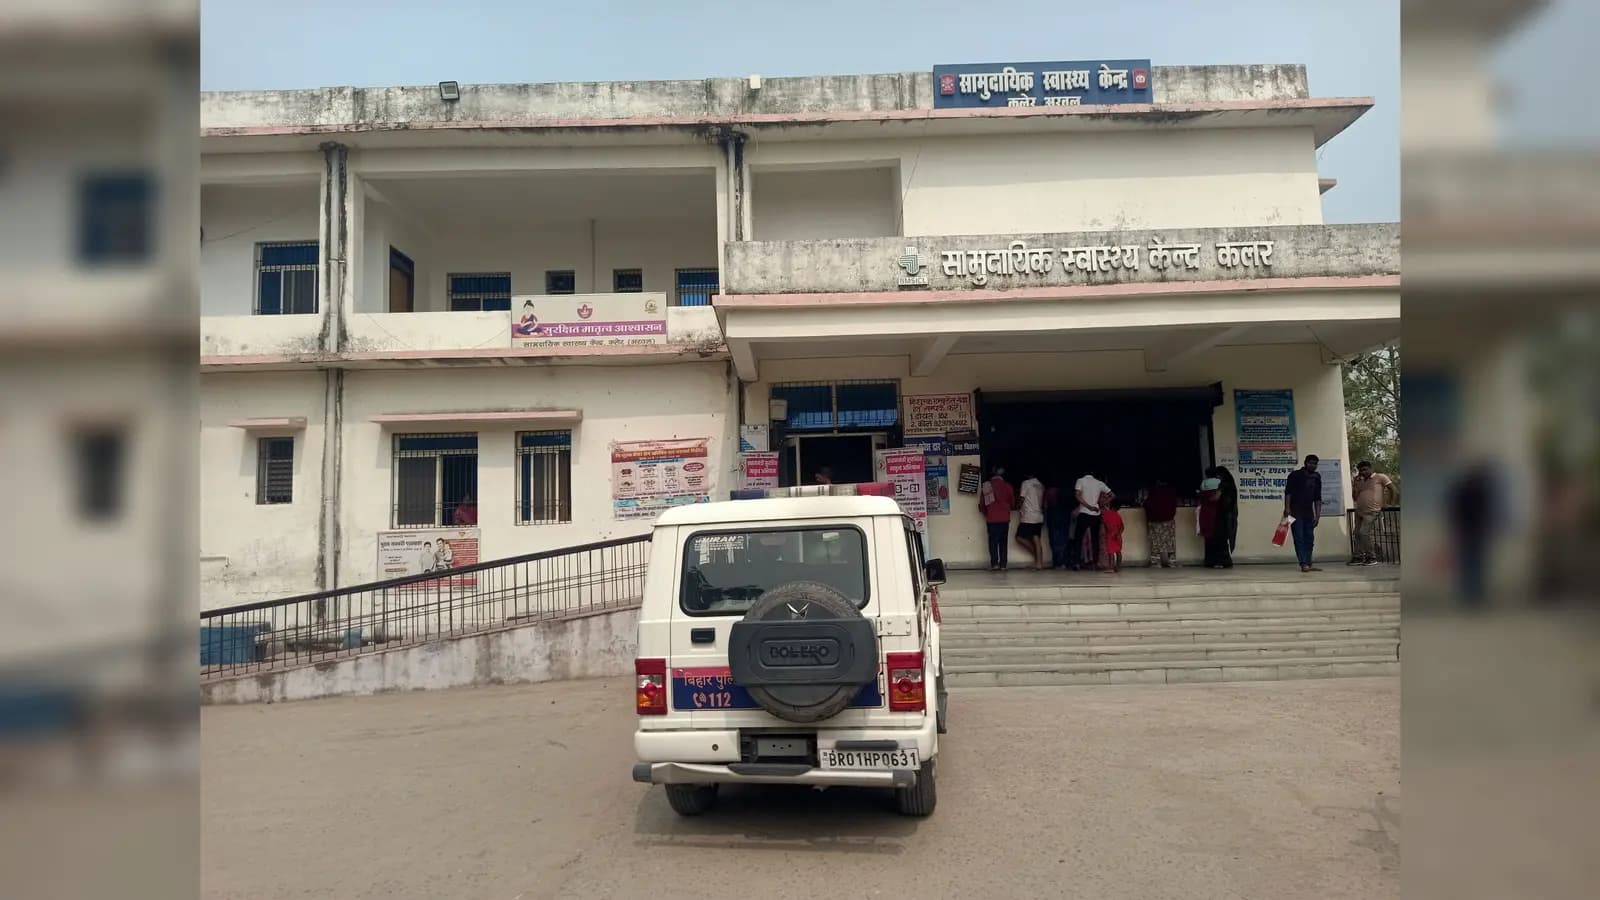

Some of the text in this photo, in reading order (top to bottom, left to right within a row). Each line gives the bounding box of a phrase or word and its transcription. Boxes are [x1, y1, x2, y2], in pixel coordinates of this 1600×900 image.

[958, 63, 1129, 100] सामुदायिक स्वास्थ्य केन्द्र
[941, 240, 1054, 286] सामुदायिक
[1061, 244, 1140, 272] स्वास्थ्य
[1216, 240, 1274, 269] कलर
[543, 323, 579, 336] सुरक्षित
[614, 322, 662, 333] आश्वासन
[684, 671, 735, 690] बिहार पुलि
[709, 692, 732, 708] 112
[828, 752, 917, 767] BR01HP0631
